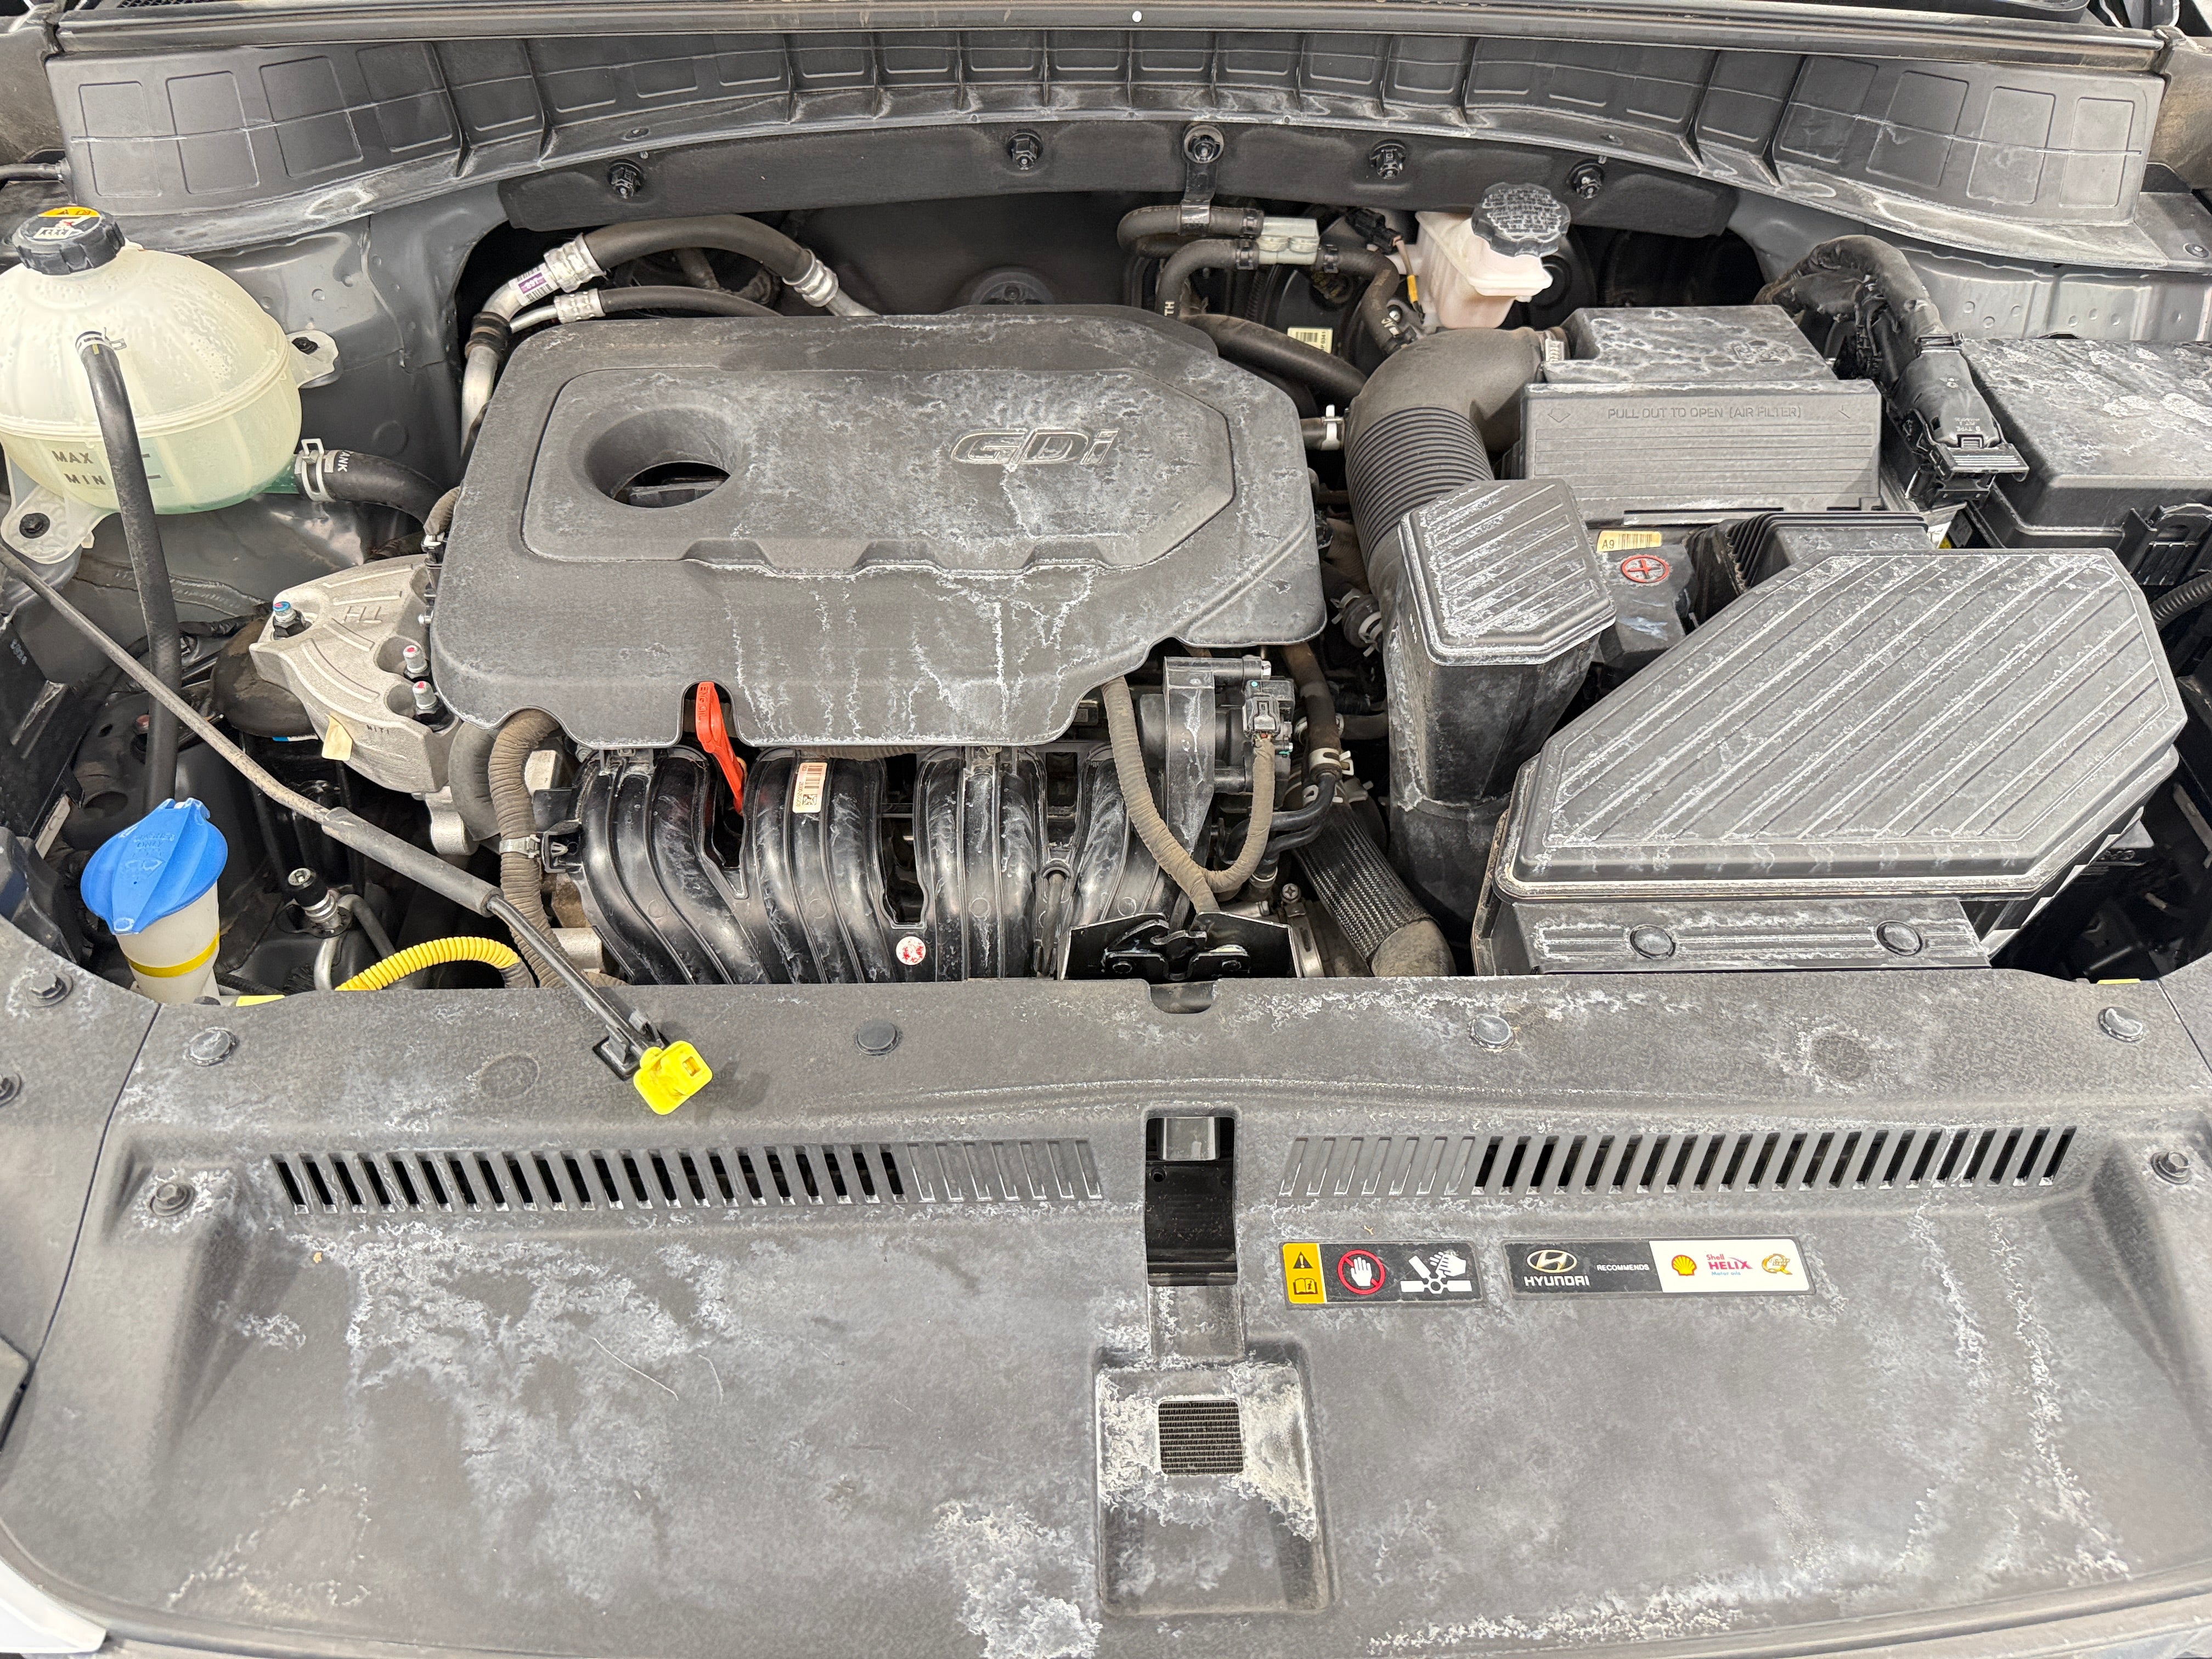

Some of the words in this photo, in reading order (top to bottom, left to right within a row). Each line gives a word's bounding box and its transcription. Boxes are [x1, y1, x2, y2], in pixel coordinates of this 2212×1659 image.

[1607, 408, 1639, 419] PULL
[1642, 408, 1667, 418] OUT
[1672, 408, 1686, 418] TO
[1690, 408, 1723, 418] OPEN
[1730, 407, 1753, 418] (AIR
[1757, 407, 1801, 418] FILTER)
[951, 427, 1120, 465] GDi
[52, 450, 94, 464] MAX
[64, 473, 106, 486] MIN
[1601, 539, 1615, 549] A9
[698, 706, 707, 720] OIL
[1708, 1261, 1753, 1270] HELIX
[1524, 1275, 1590, 1286] HYUNDAI
